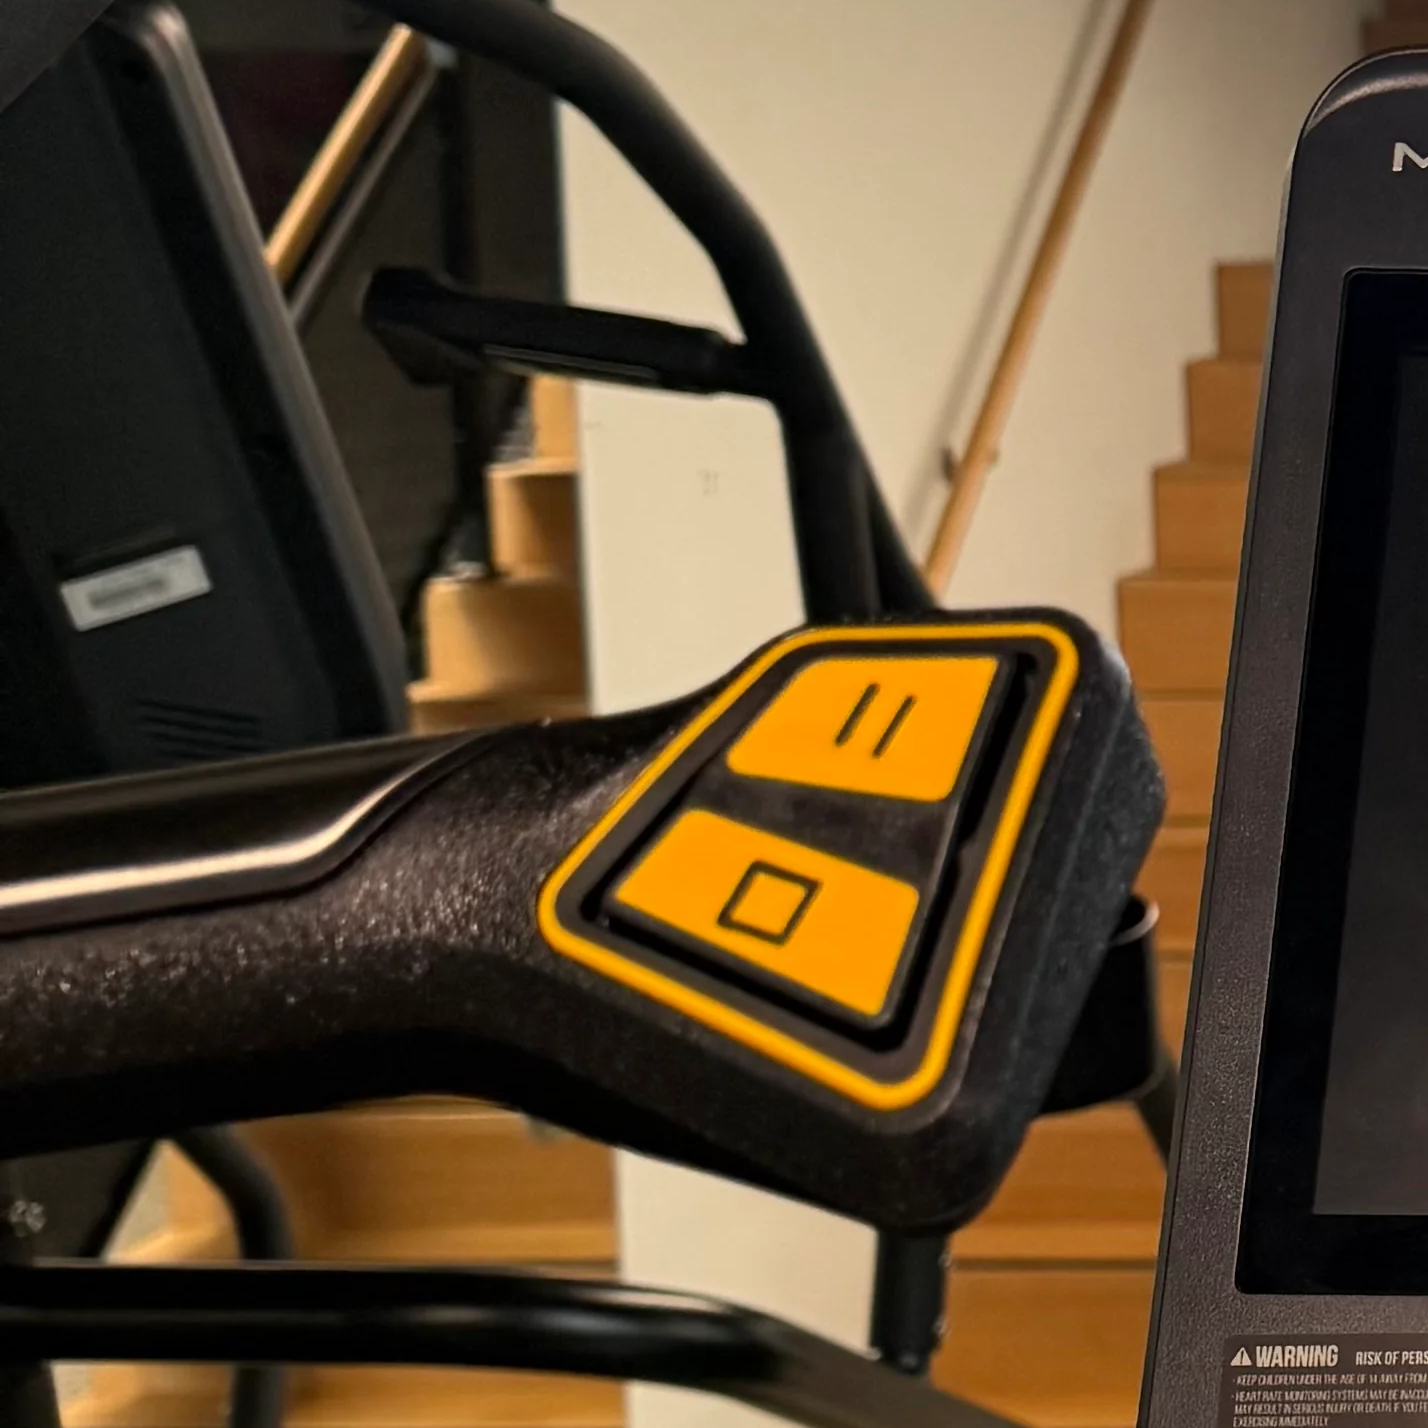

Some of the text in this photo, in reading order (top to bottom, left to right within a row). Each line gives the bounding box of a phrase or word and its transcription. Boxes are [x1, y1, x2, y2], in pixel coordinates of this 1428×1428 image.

[1256, 1345, 1339, 1368] WARNING
[1355, 1351, 1382, 1366] RISK
[1385, 1351, 1400, 1366] OF
